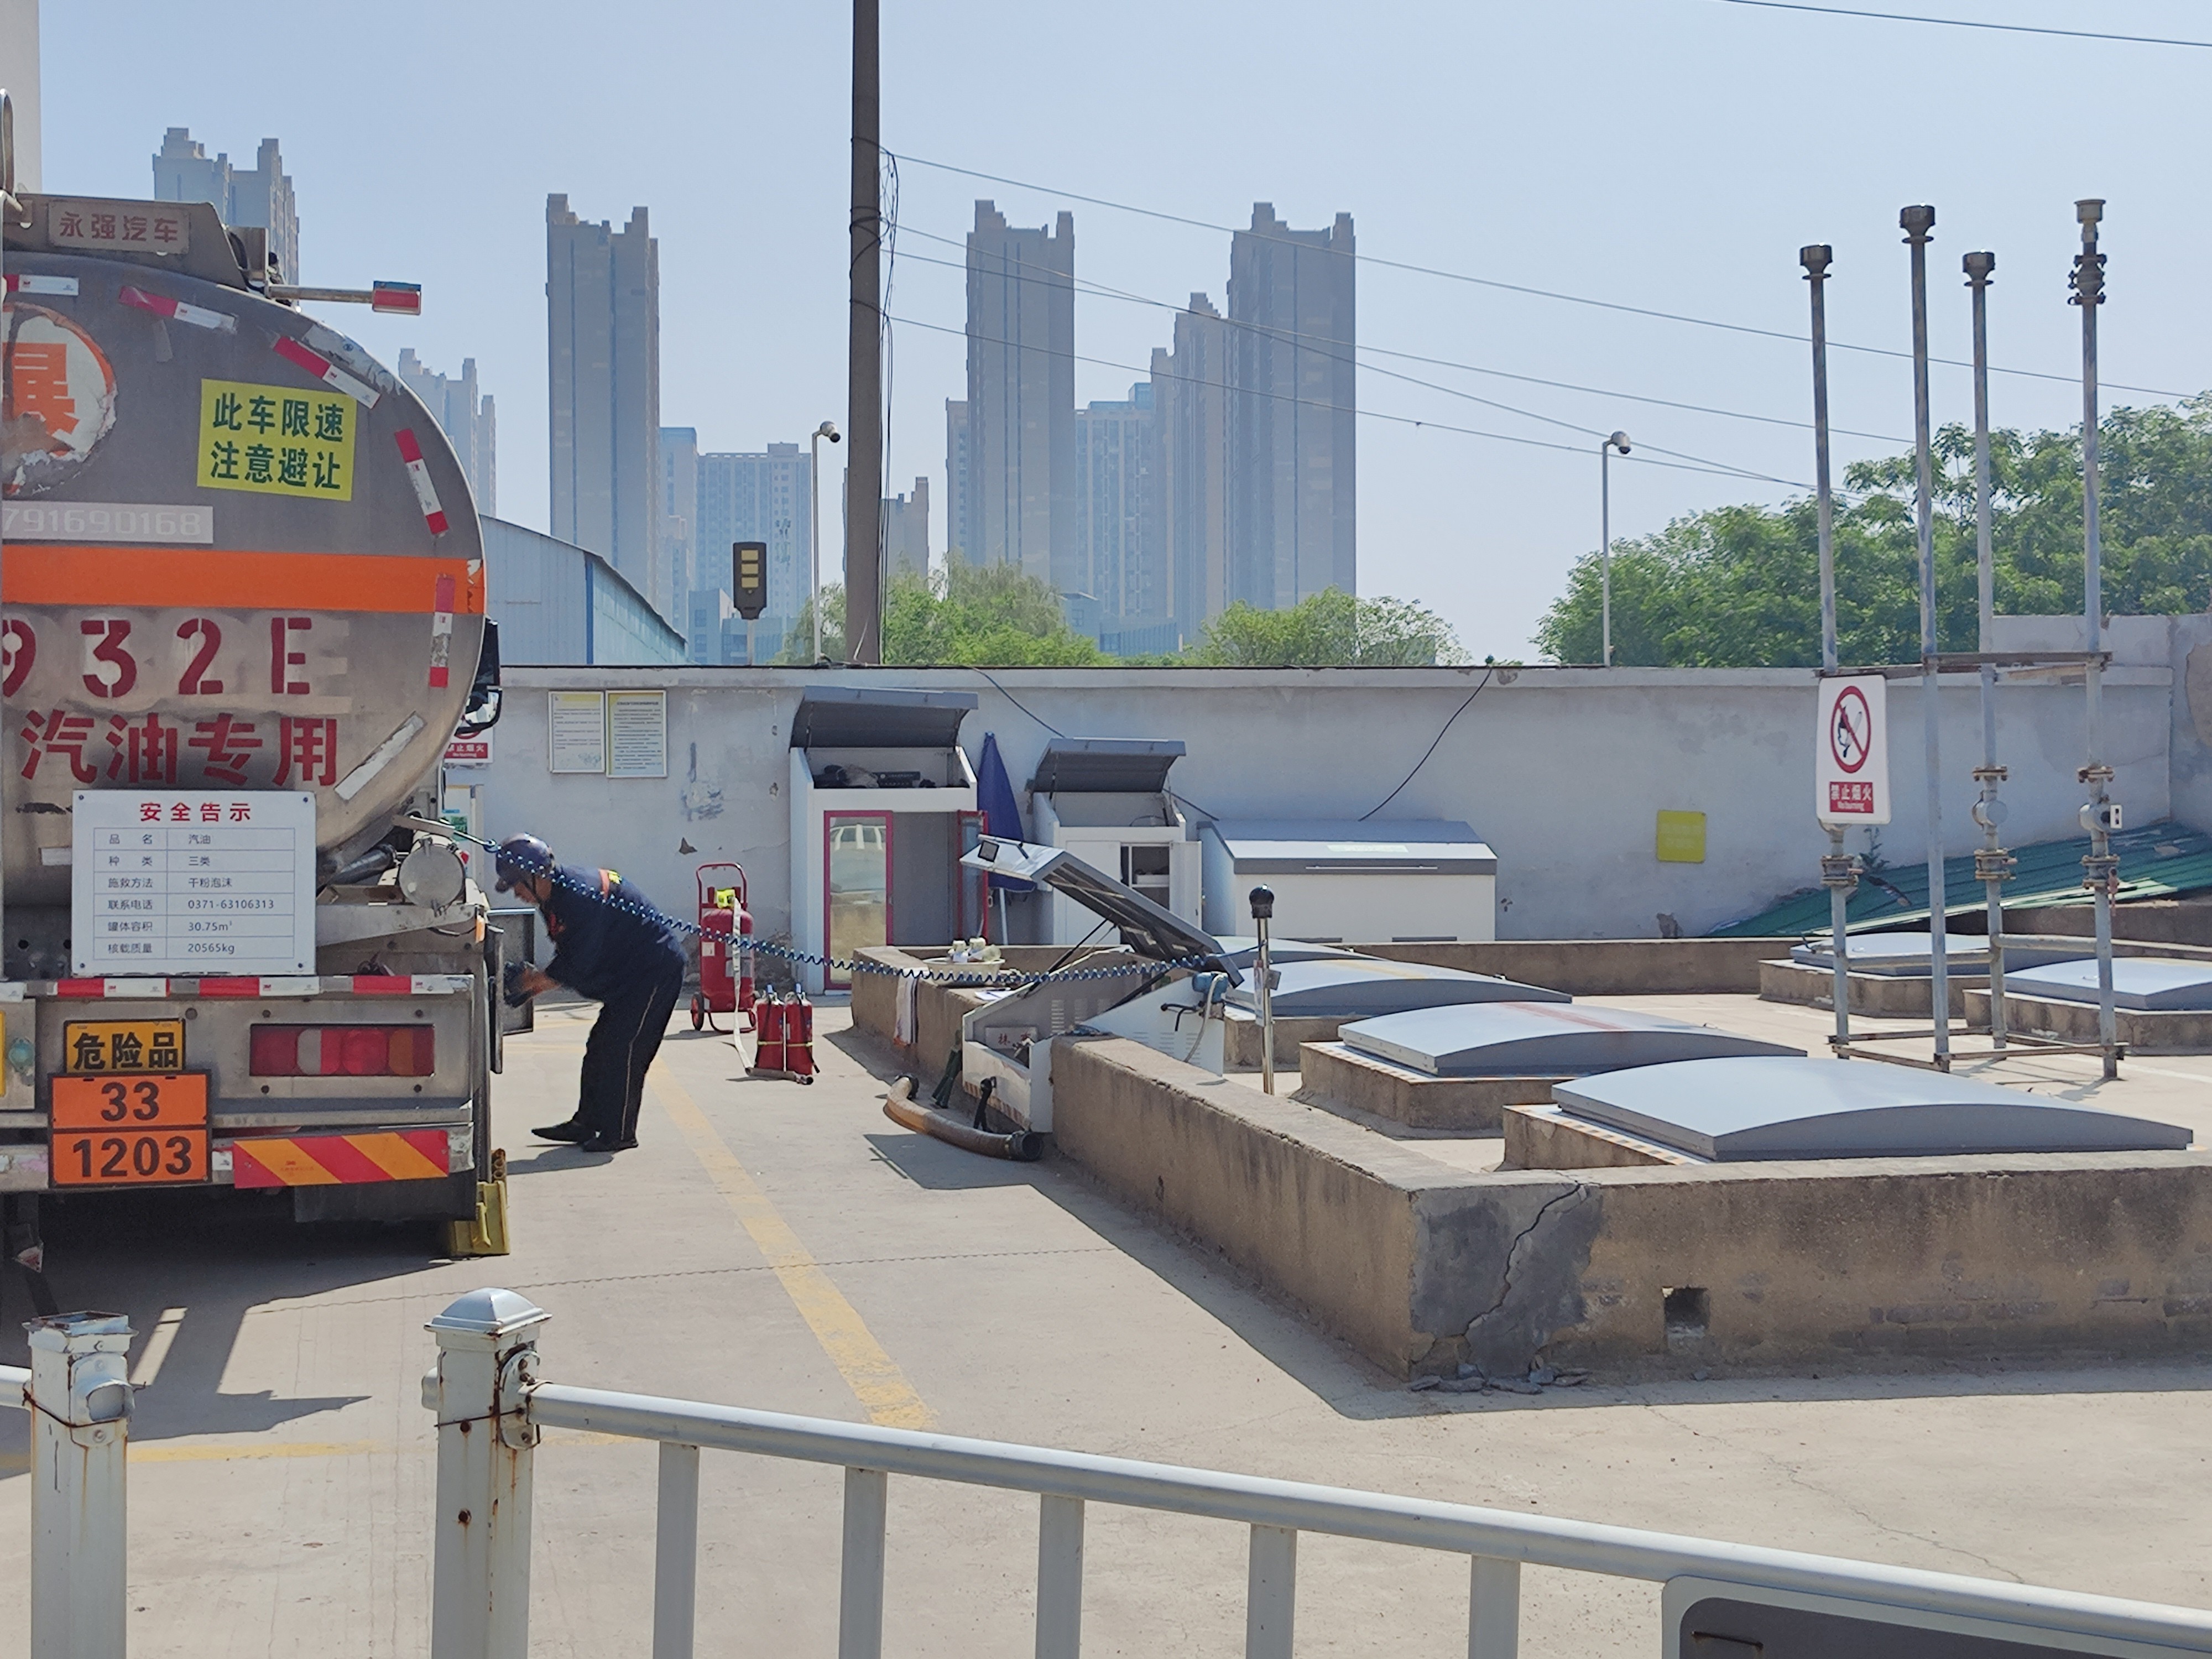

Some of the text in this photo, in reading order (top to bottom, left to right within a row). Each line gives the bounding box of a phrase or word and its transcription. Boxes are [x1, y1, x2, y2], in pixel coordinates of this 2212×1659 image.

[60, 211, 178, 243] 永强汽车
[213, 393, 343, 442] 此车限速
[211, 441, 340, 489] 注意避让
[21, 709, 337, 786] 汽油专用
[1831, 784, 1872, 801] 禁止烟火
[140, 802, 251, 822] 安全告示
[189, 834, 211, 844] 汽油
[189, 856, 210, 866] 三类
[108, 878, 232, 888] 施救方法 干粉泡沫
[108, 899, 274, 910] 联系电话 0371-63106313
[108, 921, 153, 931] 罐体容积
[108, 943, 234, 954] 核载质量 20565kg
[73, 1032, 179, 1070] 危险品
[101, 1081, 160, 1121] 33
[73, 1136, 192, 1178] 1203
